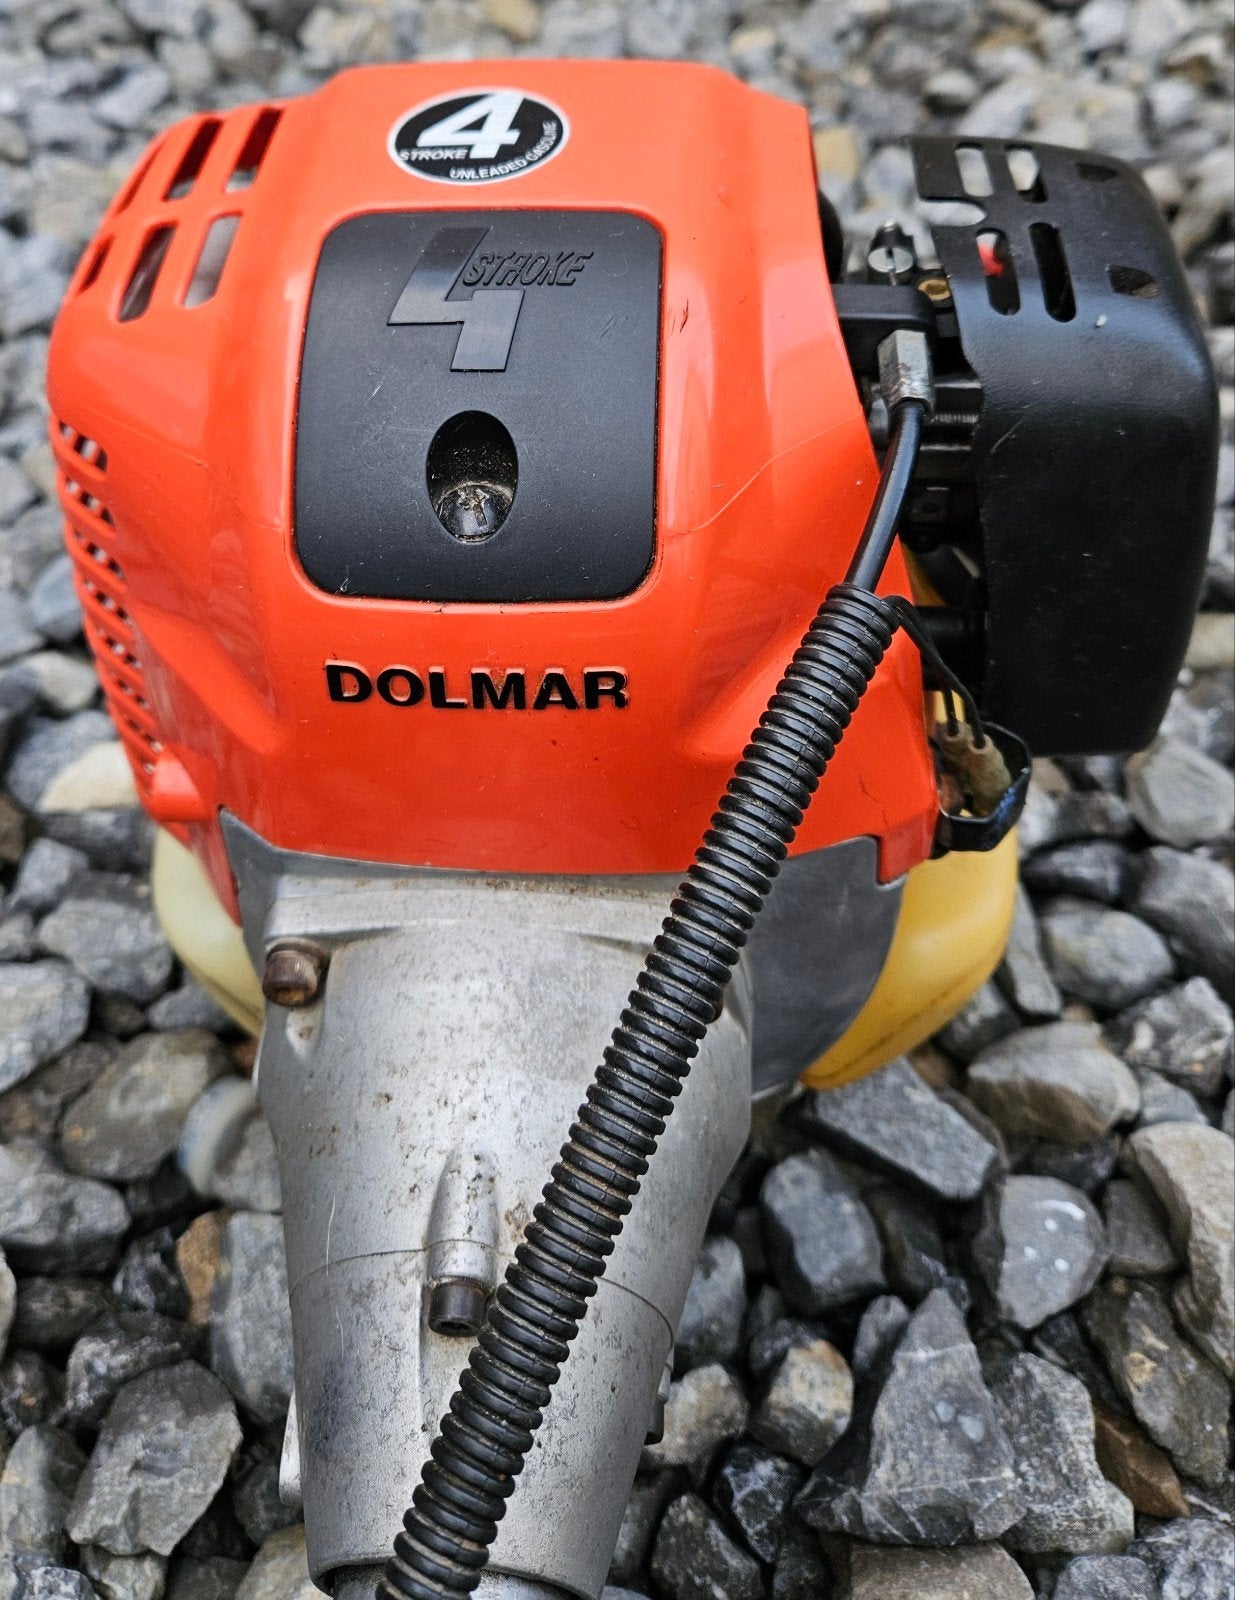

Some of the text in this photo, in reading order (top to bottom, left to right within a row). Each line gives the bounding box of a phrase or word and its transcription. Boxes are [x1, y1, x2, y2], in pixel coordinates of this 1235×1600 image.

[416, 91, 525, 159] 4
[450, 119, 558, 180] UNLEADED GASOLINE
[400, 148, 468, 161] STROKE
[462, 251, 595, 287] STROKE
[387, 227, 525, 373] 4
[325, 658, 628, 710] DOLMAR
